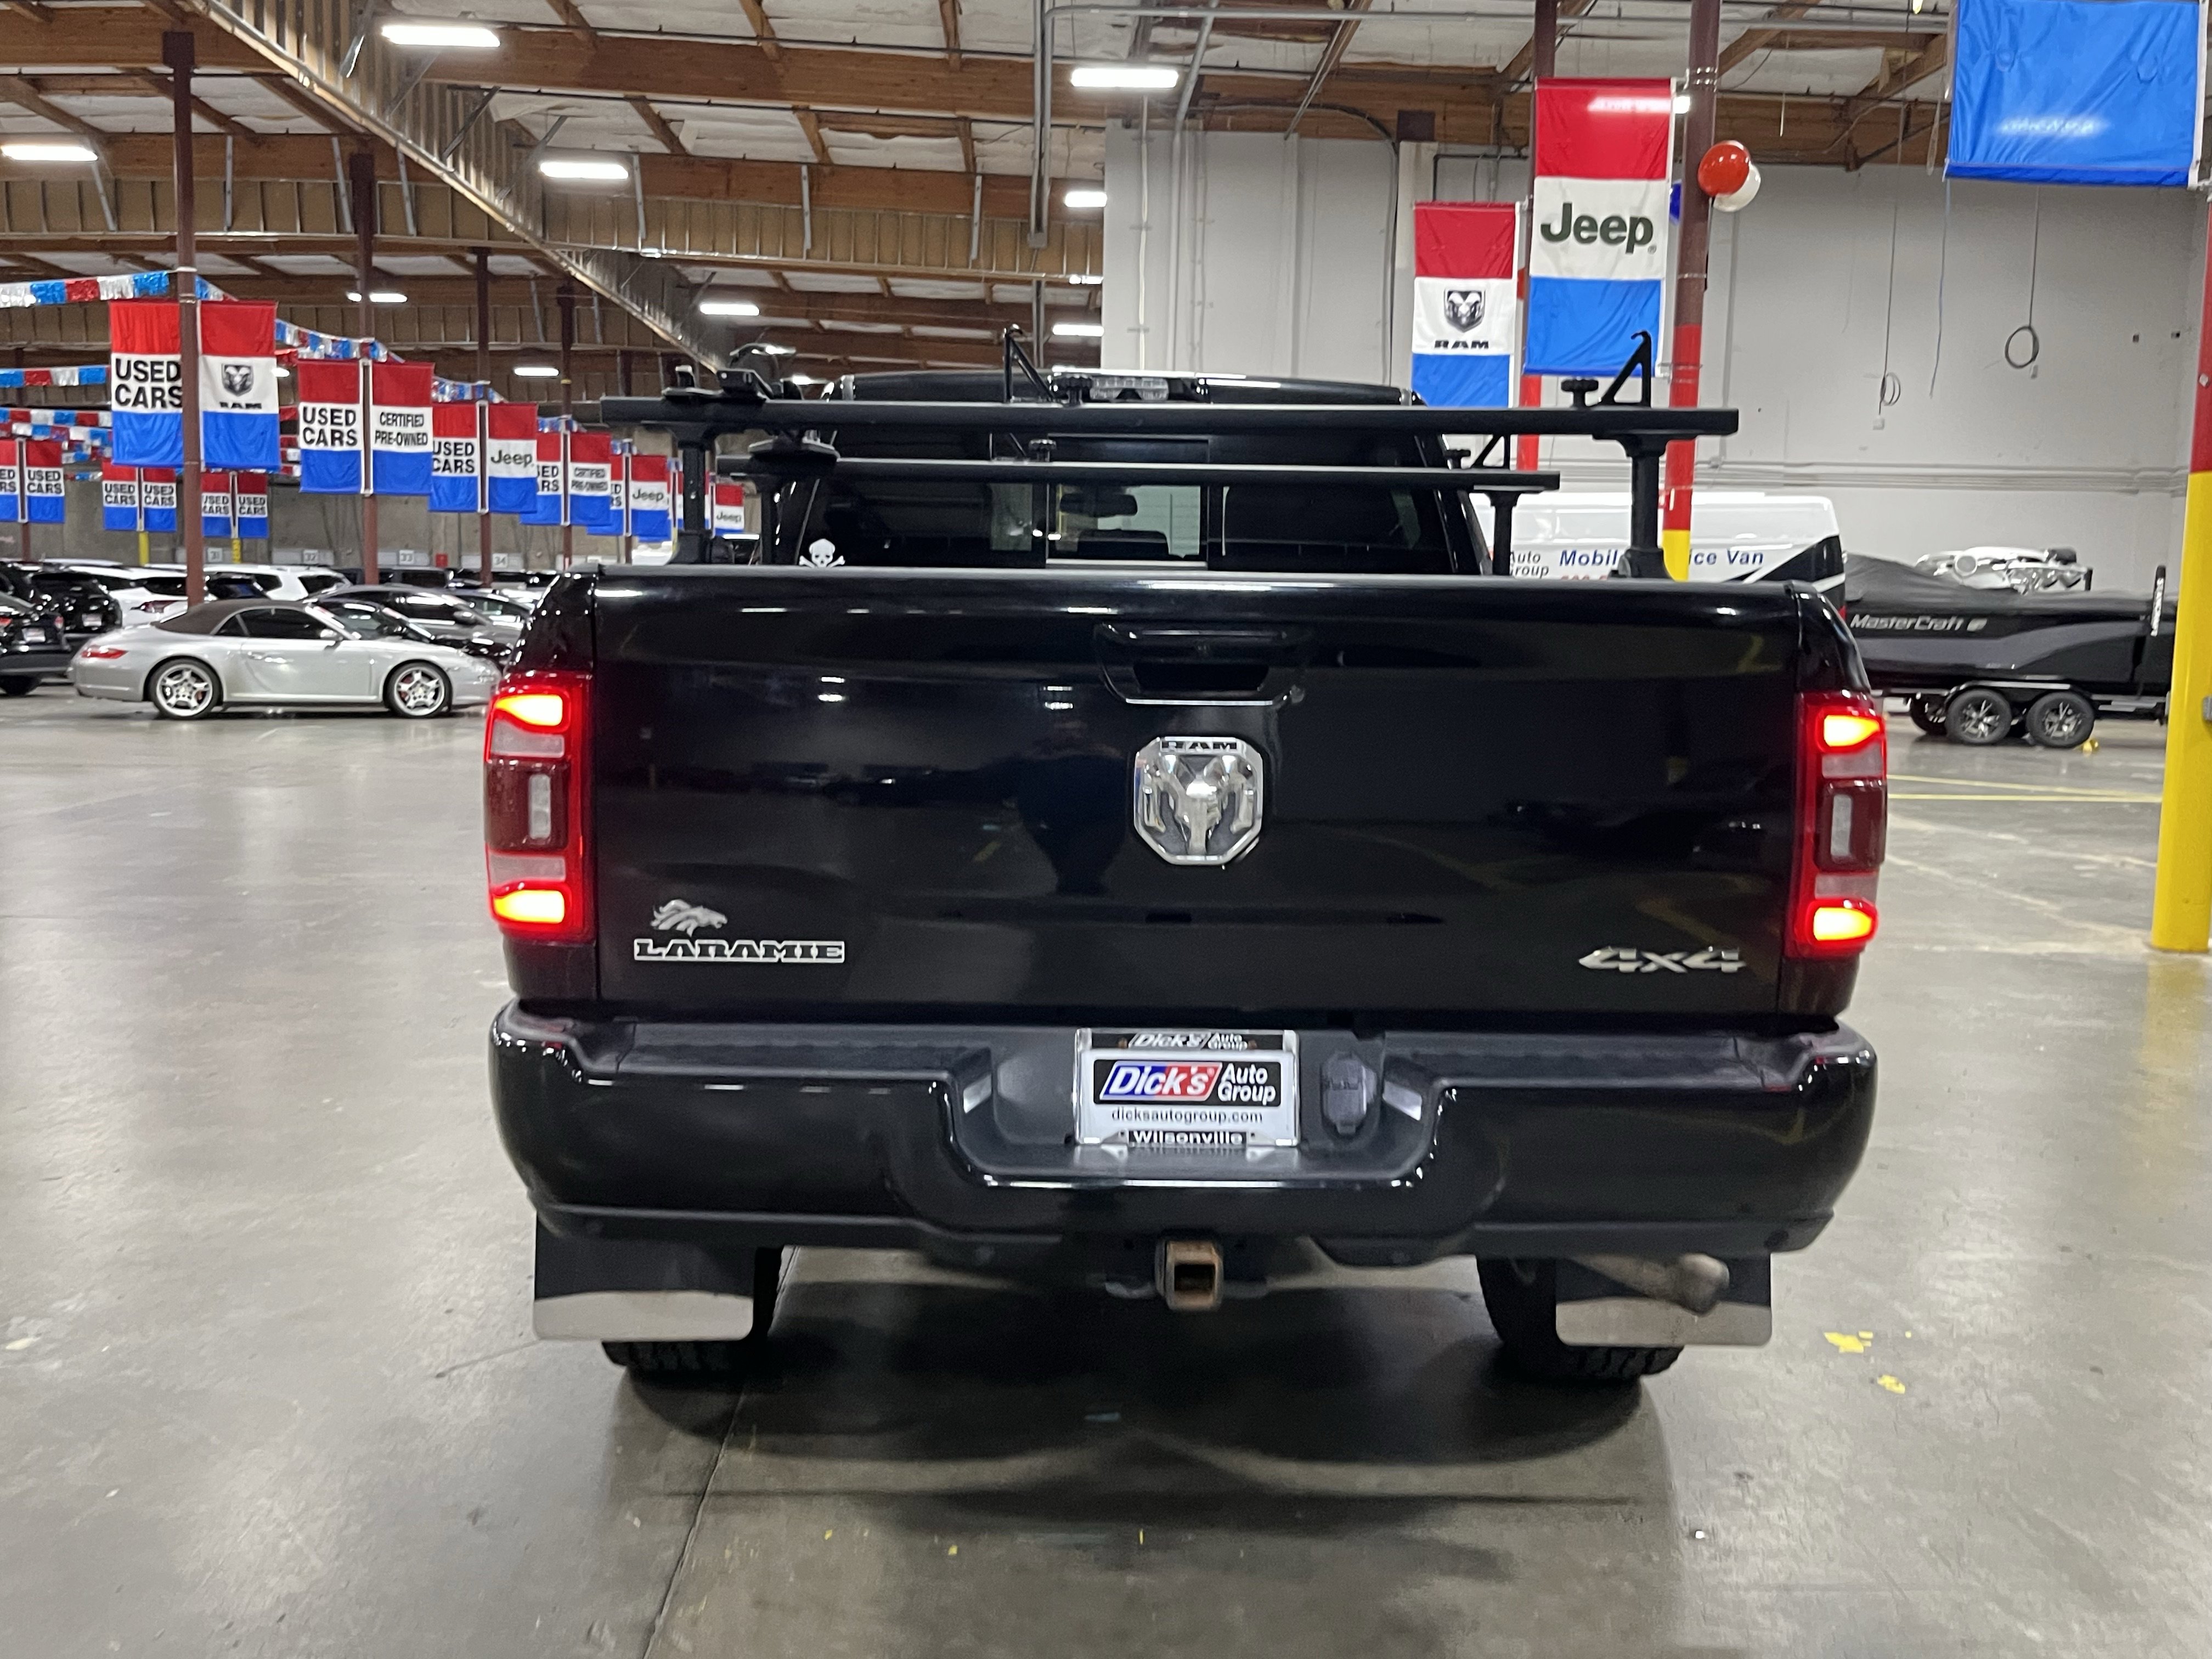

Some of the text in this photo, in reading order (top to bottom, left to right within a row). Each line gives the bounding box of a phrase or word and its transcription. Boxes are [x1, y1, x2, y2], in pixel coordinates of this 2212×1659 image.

[1541, 202, 1654, 254] Jeep
[1434, 340, 1489, 350] RAM
[115, 358, 180, 383] USED
[115, 383, 182, 409] CARS
[302, 407, 356, 426] USED
[380, 412, 424, 427] CERTIFIED
[302, 427, 358, 447] CARS
[375, 430, 428, 445] PRE-OWNED
[433, 441, 475, 456] USED
[432, 458, 475, 473] CARS
[491, 450, 533, 468] Jeep
[0, 469, 15, 479] ED
[27, 470, 61, 481] USED
[538, 465, 559, 477] ED
[0, 483, 16, 493] RS
[27, 482, 62, 494] CARS
[105, 483, 136, 493] USED
[144, 484, 174, 495] USED
[538, 479, 559, 492] RS
[105, 494, 136, 505] CARS
[144, 495, 174, 506] CARS
[239, 496, 266, 505] USED
[633, 489, 664, 501] Jeep
[1560, 549, 1618, 566] Mobil
[1727, 550, 1764, 565] Van
[1510, 565, 1549, 579] roup
[1850, 614, 1965, 631] MasterCraft
[1161, 741, 1238, 750] RAM
[634, 938, 845, 963] LARAMIE
[1109, 1066, 1210, 1095] Dick's
[1221, 1063, 1268, 1085] Auto
[1217, 1083, 1276, 1105] Group
[1113, 1107, 1263, 1124] dicksautogroup.com
[1133, 1130, 1243, 1145] Wilsonville
